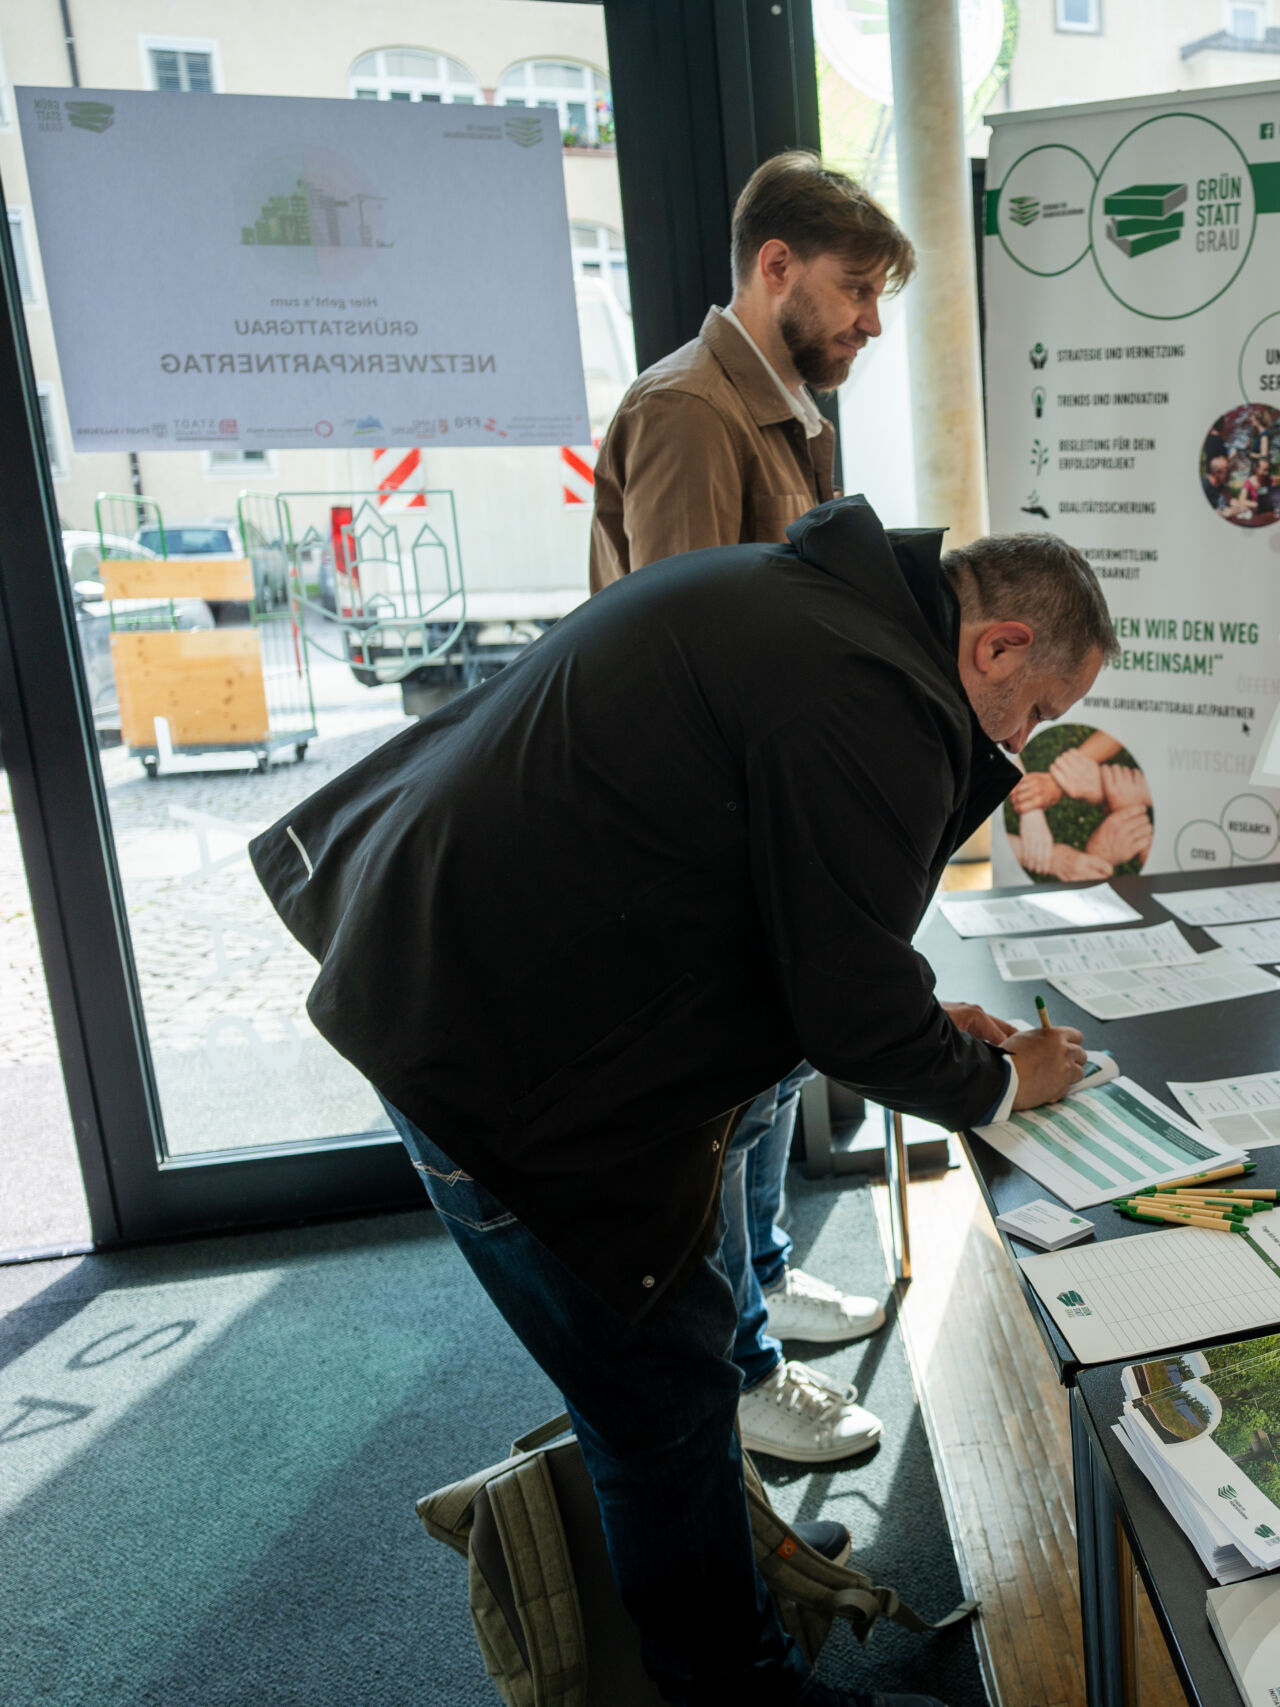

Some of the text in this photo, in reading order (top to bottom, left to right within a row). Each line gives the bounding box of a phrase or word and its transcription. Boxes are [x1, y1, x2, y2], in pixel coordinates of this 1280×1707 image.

[1196, 173, 1242, 202] GRÜN
[1196, 203, 1242, 227] STATT
[1196, 229, 1240, 253] GRAU
[1057, 344, 1186, 362] STRATEGIE UND VERNETZUNG
[1058, 392, 1170, 407] TRENDS UND INNOVATION
[1059, 436, 1156, 452] BEGLEITUNG FÜR DEIN
[1145, 618, 1178, 640] WIR
[1182, 620, 1215, 643] DEN
[1219, 622, 1259, 645] WEG
[1229, 821, 1272, 835] RESEARCH
[1190, 848, 1216, 861] CITIES
